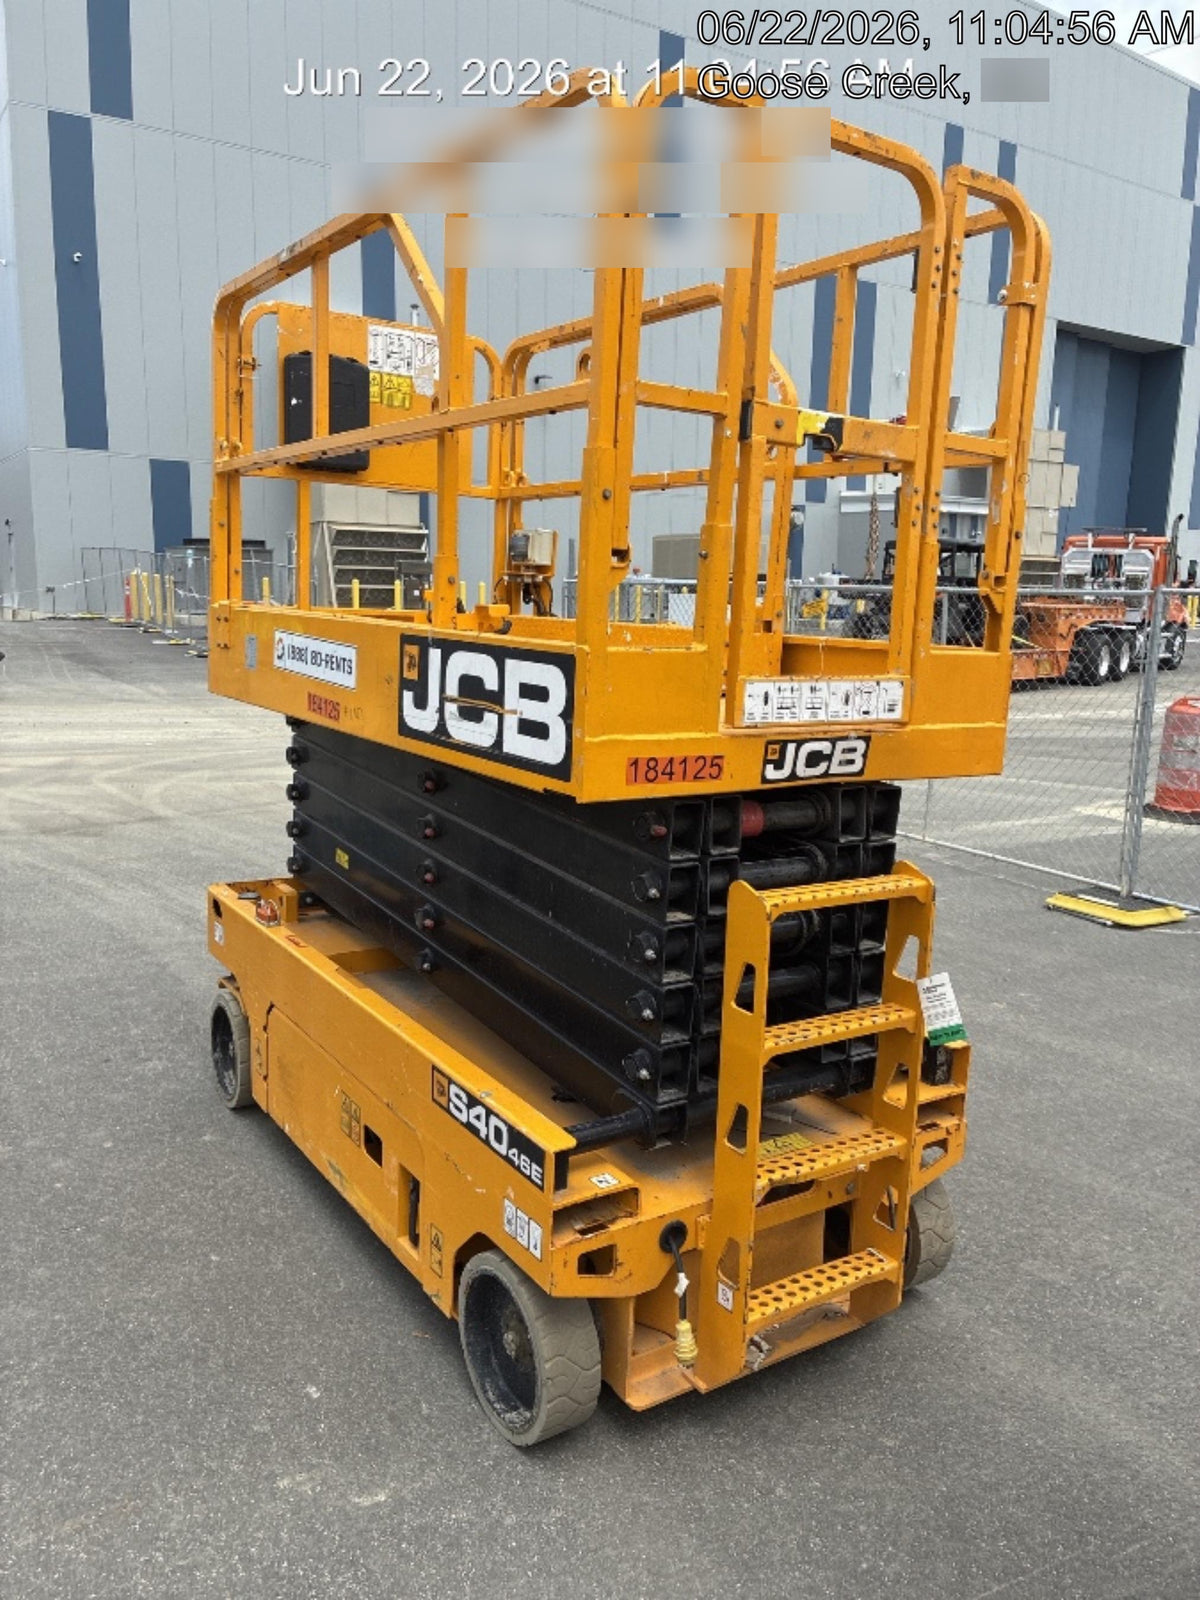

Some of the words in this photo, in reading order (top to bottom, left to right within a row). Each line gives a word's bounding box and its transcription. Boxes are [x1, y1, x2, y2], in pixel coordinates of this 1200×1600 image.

[402, 647, 567, 765] JCB
[628, 756, 723, 784] 184125
[764, 739, 867, 780] JCB
